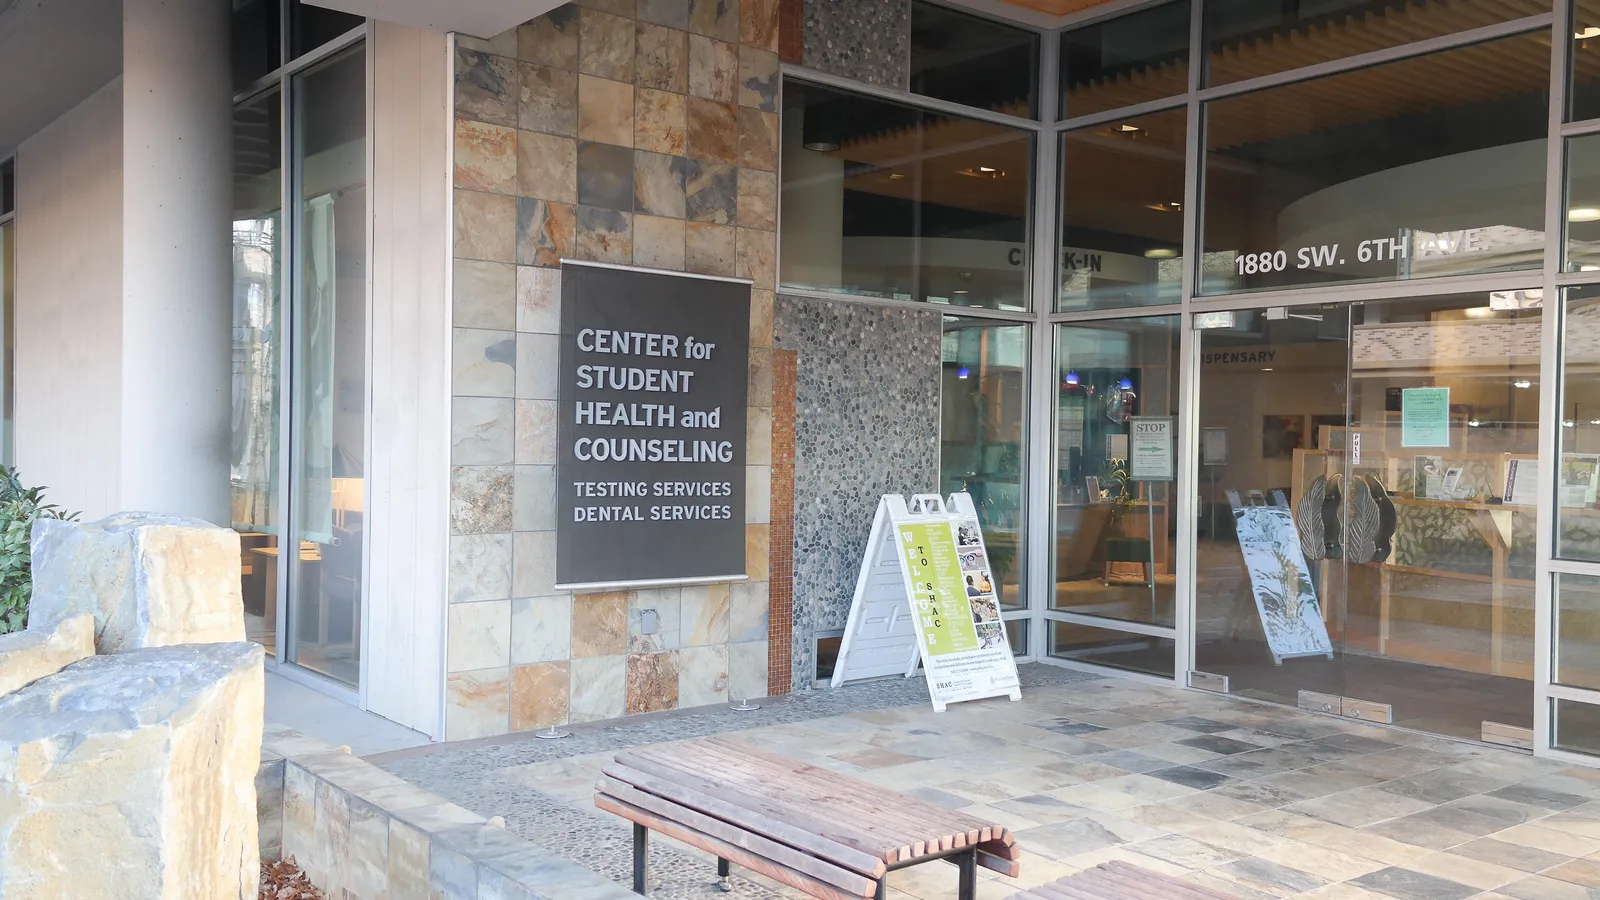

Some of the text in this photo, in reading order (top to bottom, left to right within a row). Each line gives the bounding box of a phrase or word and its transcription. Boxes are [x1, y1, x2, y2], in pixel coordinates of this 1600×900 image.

[1008, 247, 1102, 273] CK-IN
[1234, 250, 1287, 276] 1880
[1297, 244, 1345, 269] SW.
[1357, 236, 1407, 263] 6TH
[577, 328, 716, 360] CENTER for
[1201, 351, 1276, 364] ISPENSARY
[576, 365, 694, 393] STUDENT
[575, 401, 721, 429] HEALTH and
[1136, 423, 1166, 433] STOP
[574, 437, 733, 463] COUNSELING
[574, 482, 732, 497] TESTING SERVICES
[574, 505, 732, 522] DENTAL SERVICES
